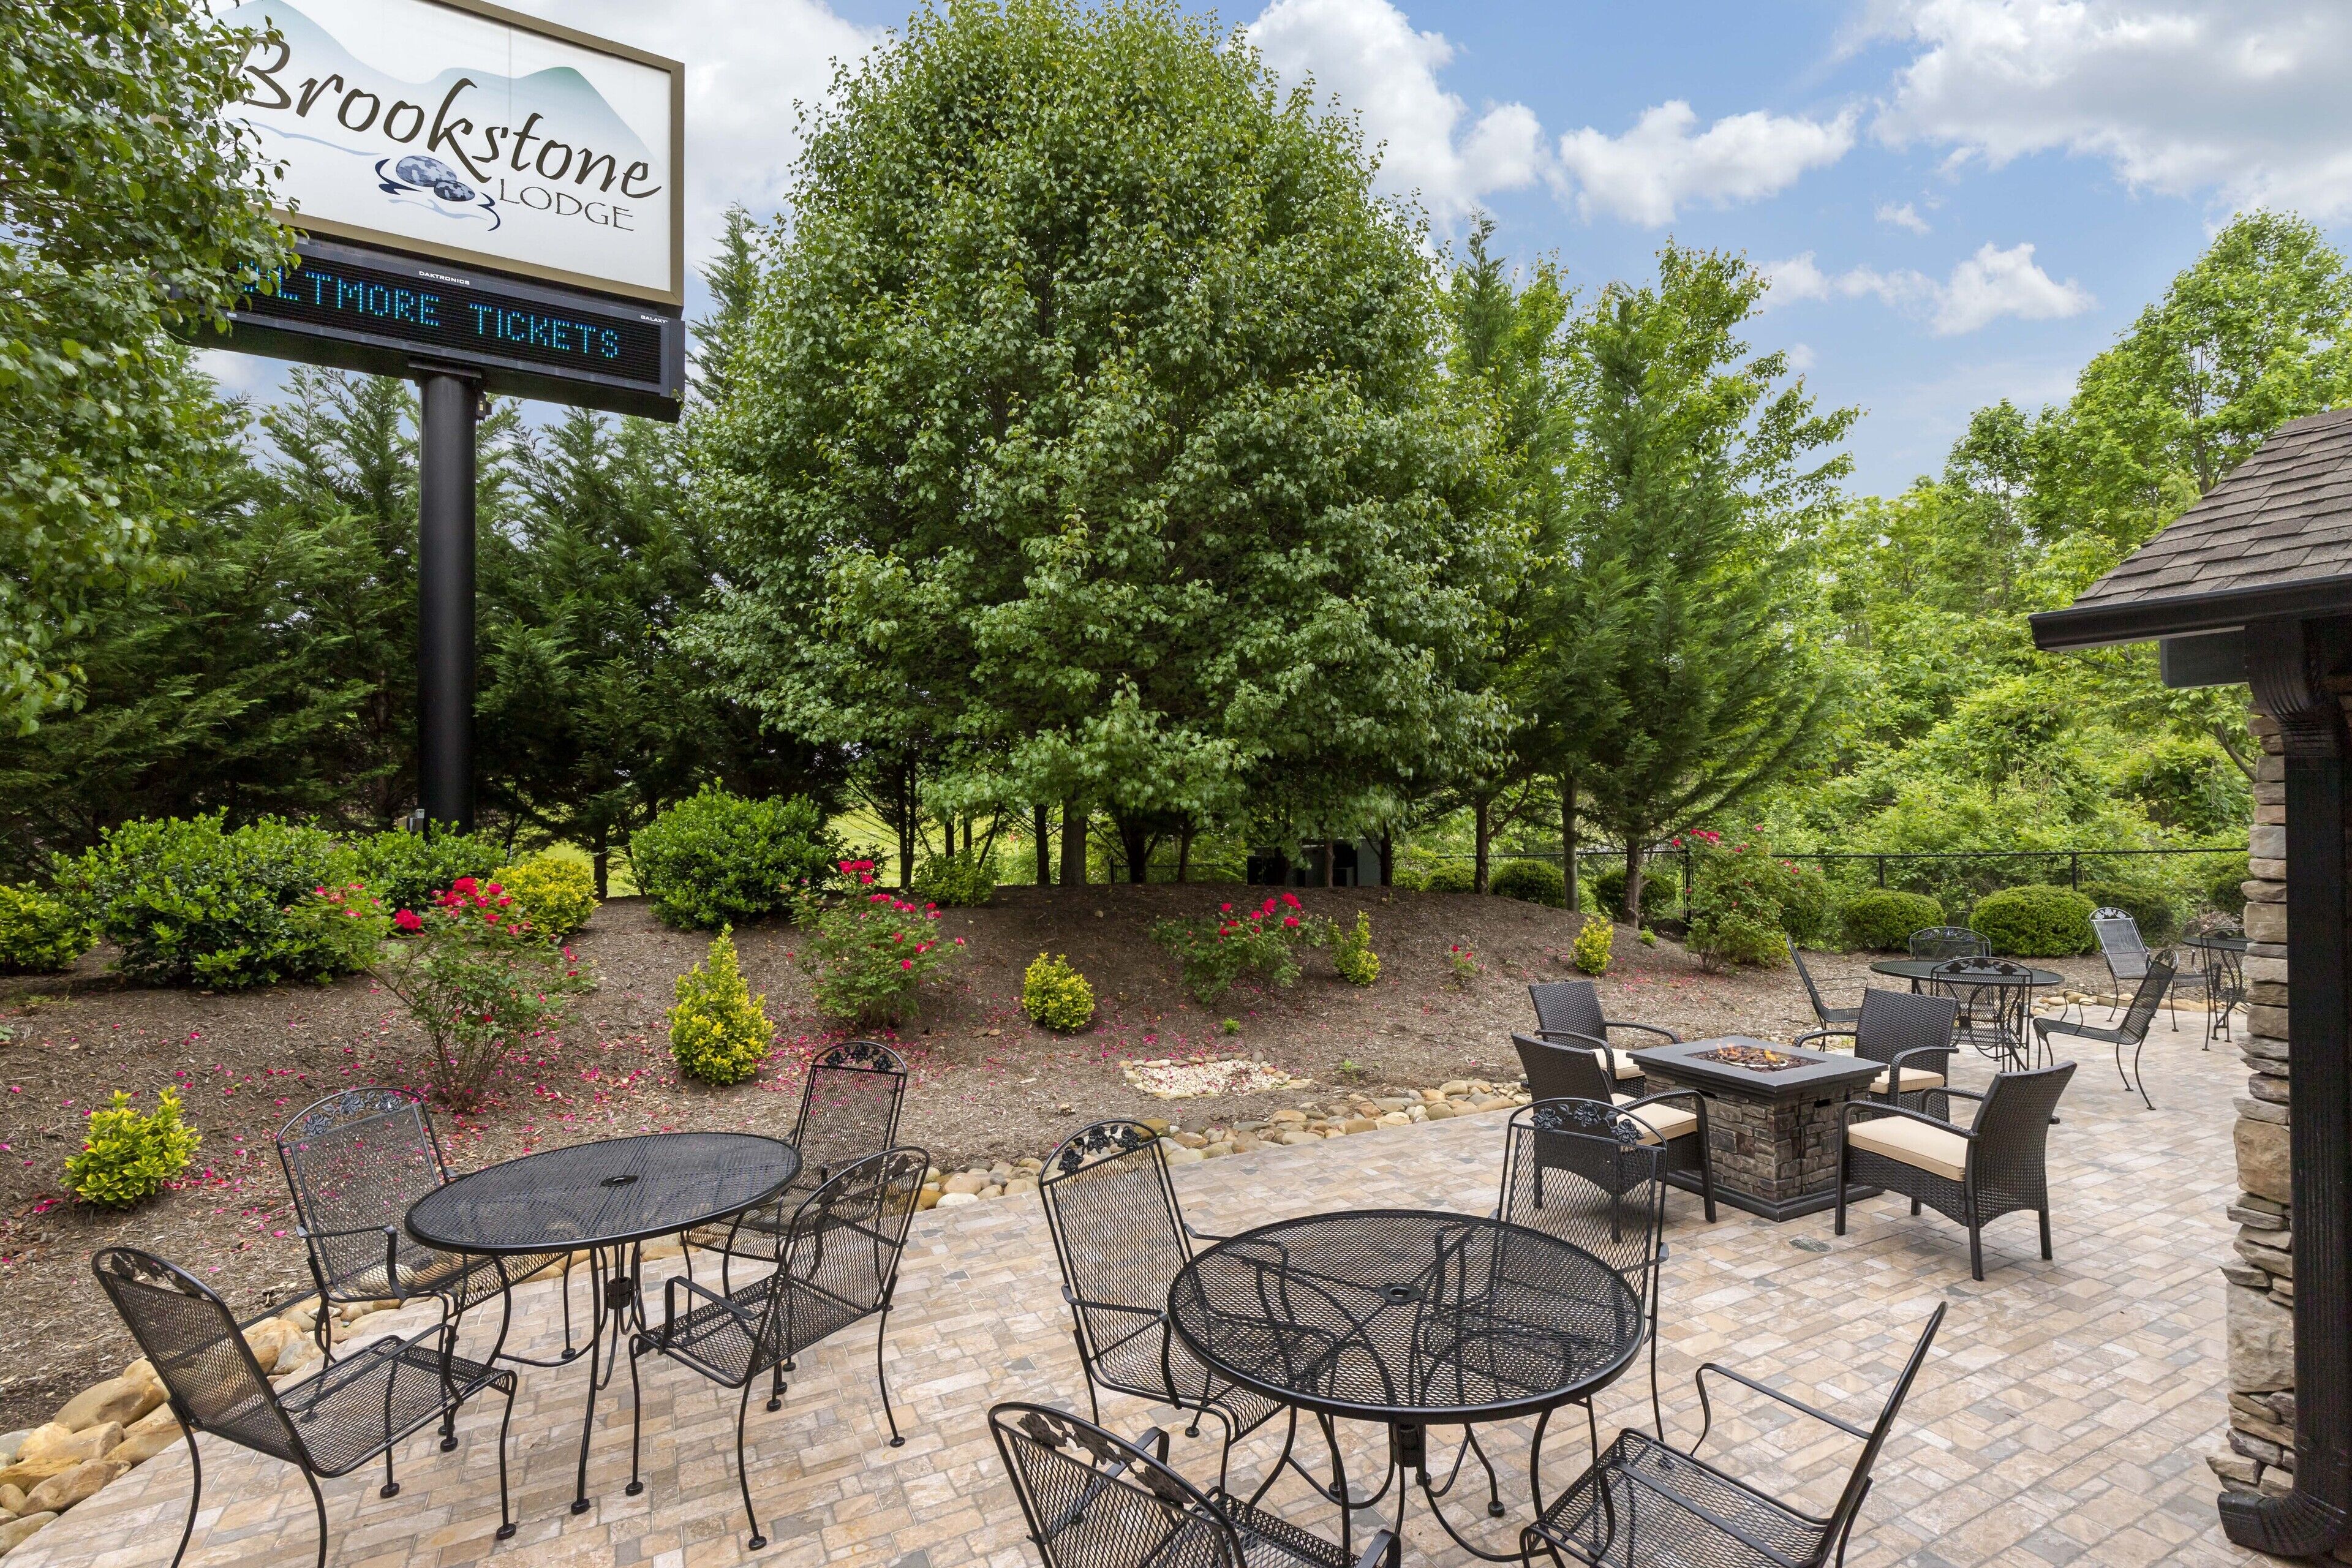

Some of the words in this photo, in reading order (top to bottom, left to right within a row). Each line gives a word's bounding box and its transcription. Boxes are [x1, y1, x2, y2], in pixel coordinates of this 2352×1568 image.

[211, 36, 662, 198] Brookstone
[499, 178, 635, 232] LODGE
[418, 271, 470, 285] DAKTRONICS
[469, 303, 618, 358] TICKETS
[640, 315, 666, 324] GALAXY
